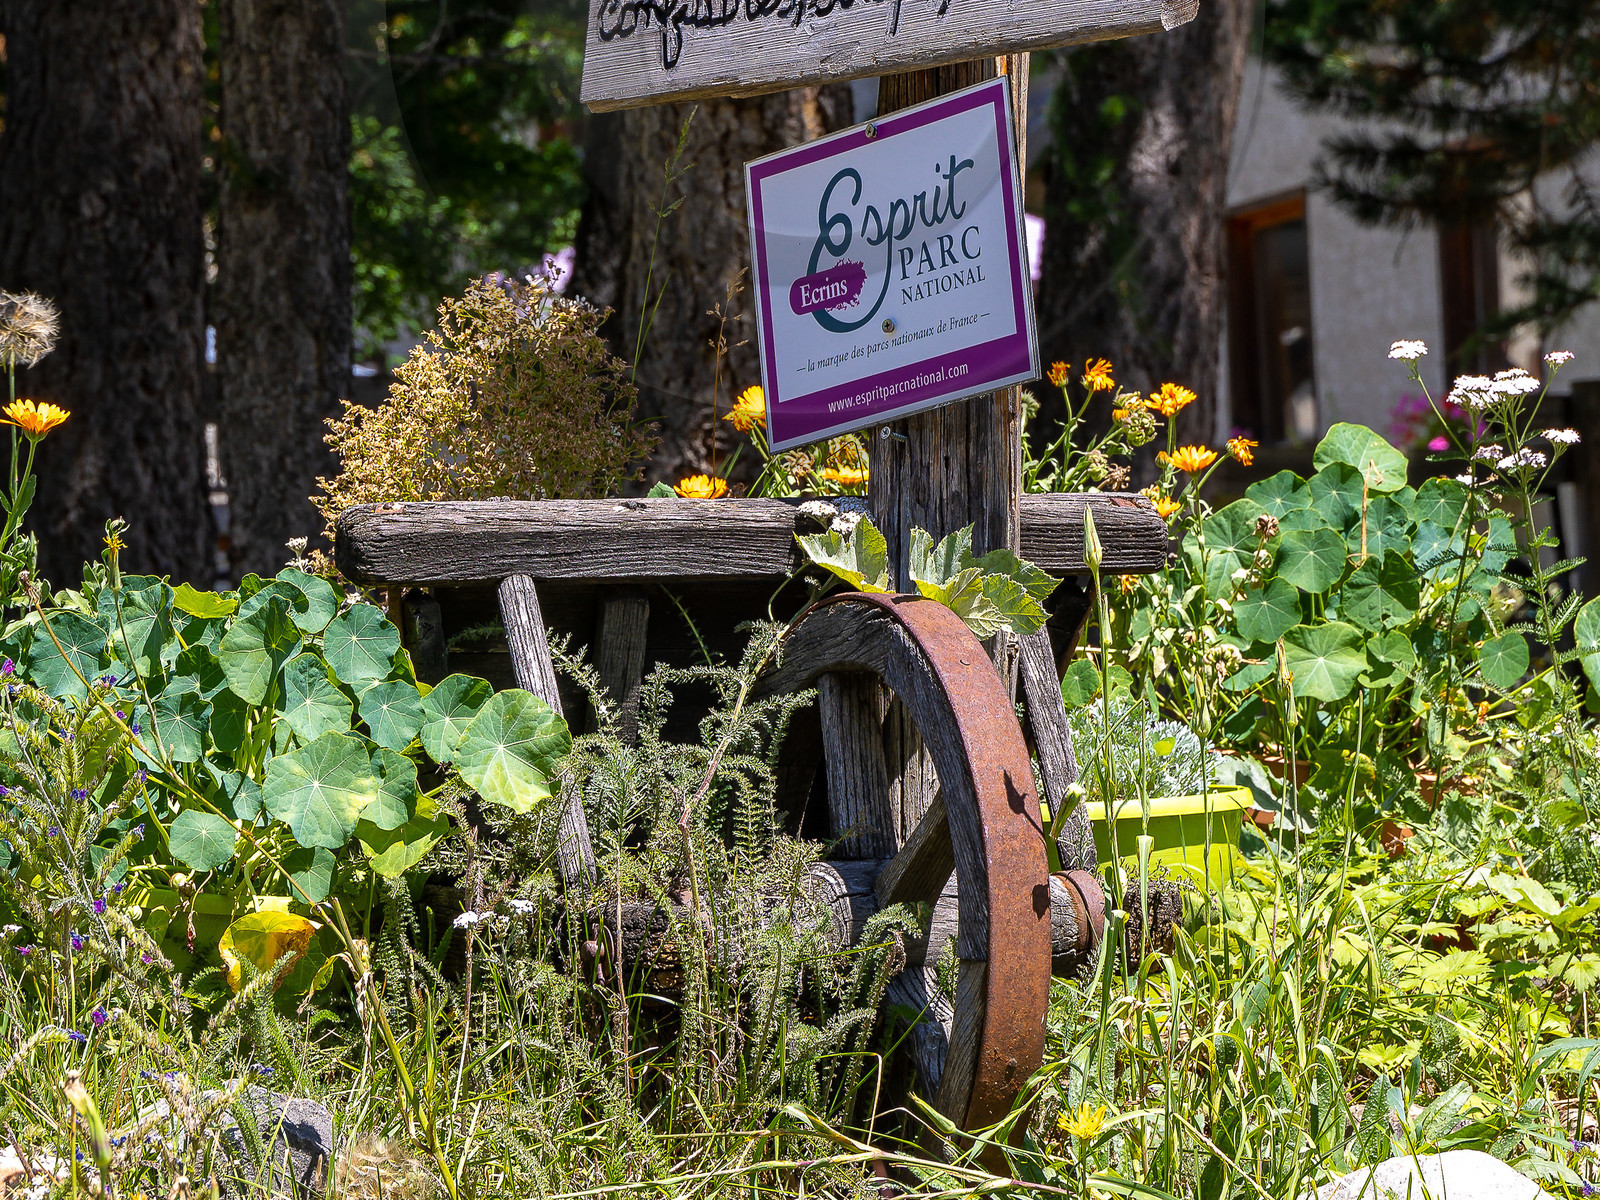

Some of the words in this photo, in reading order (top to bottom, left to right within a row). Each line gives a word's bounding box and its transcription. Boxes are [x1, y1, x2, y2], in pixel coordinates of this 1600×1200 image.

[898, 226, 983, 280] PARC
[799, 276, 848, 308] Ecrins
[901, 265, 985, 305] NATIONAL
[817, 353, 849, 368] marque
[851, 346, 865, 359] des
[867, 340, 889, 358] parcs
[891, 326, 934, 348] nationaux
[937, 321, 947, 334] de
[949, 313, 978, 331] France
[827, 362, 969, 413] www.espritparcnational.com
